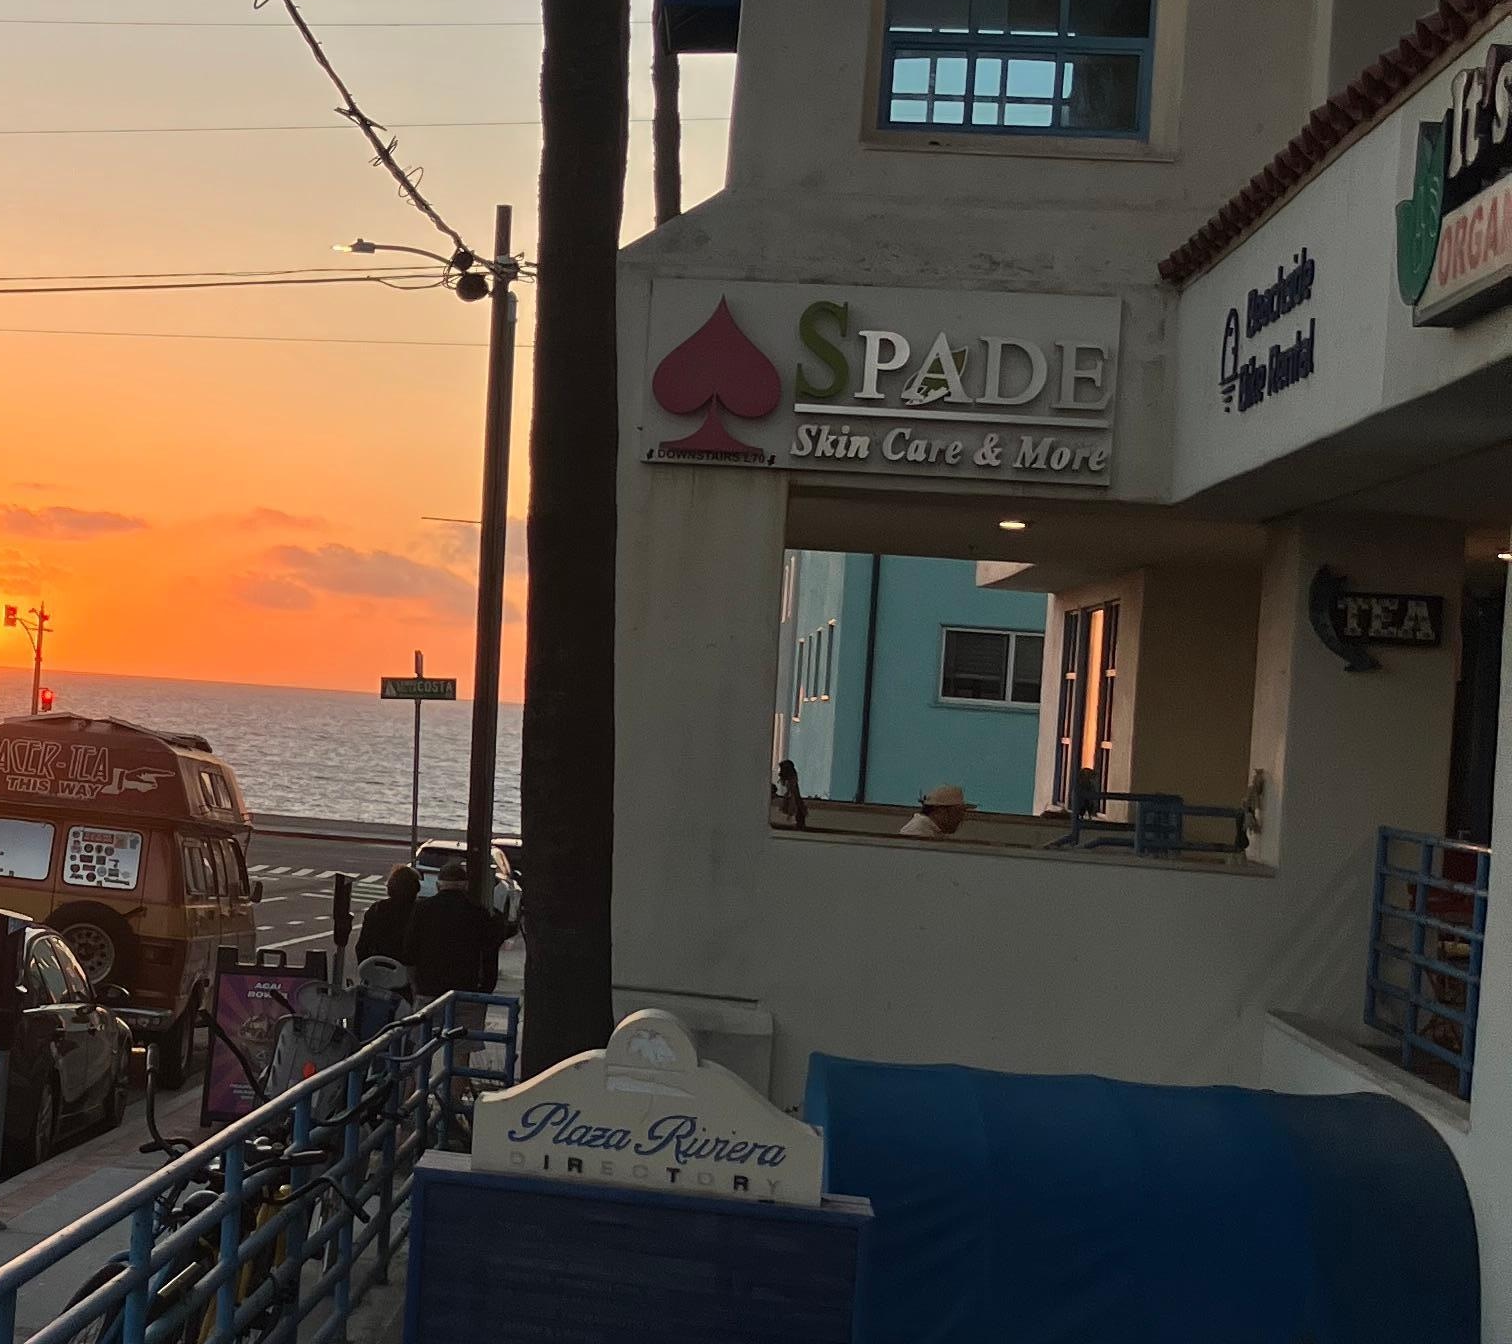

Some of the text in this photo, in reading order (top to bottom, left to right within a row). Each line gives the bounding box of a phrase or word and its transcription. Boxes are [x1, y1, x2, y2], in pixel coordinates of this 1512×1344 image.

[794, 300, 1113, 412] SPADE
[790, 423, 1108, 473] Skin Care & More
[1337, 597, 1437, 641] TEA
[6, 774, 103, 800] THIS WAY
[508, 1102, 786, 1168] Plaza Riviera
